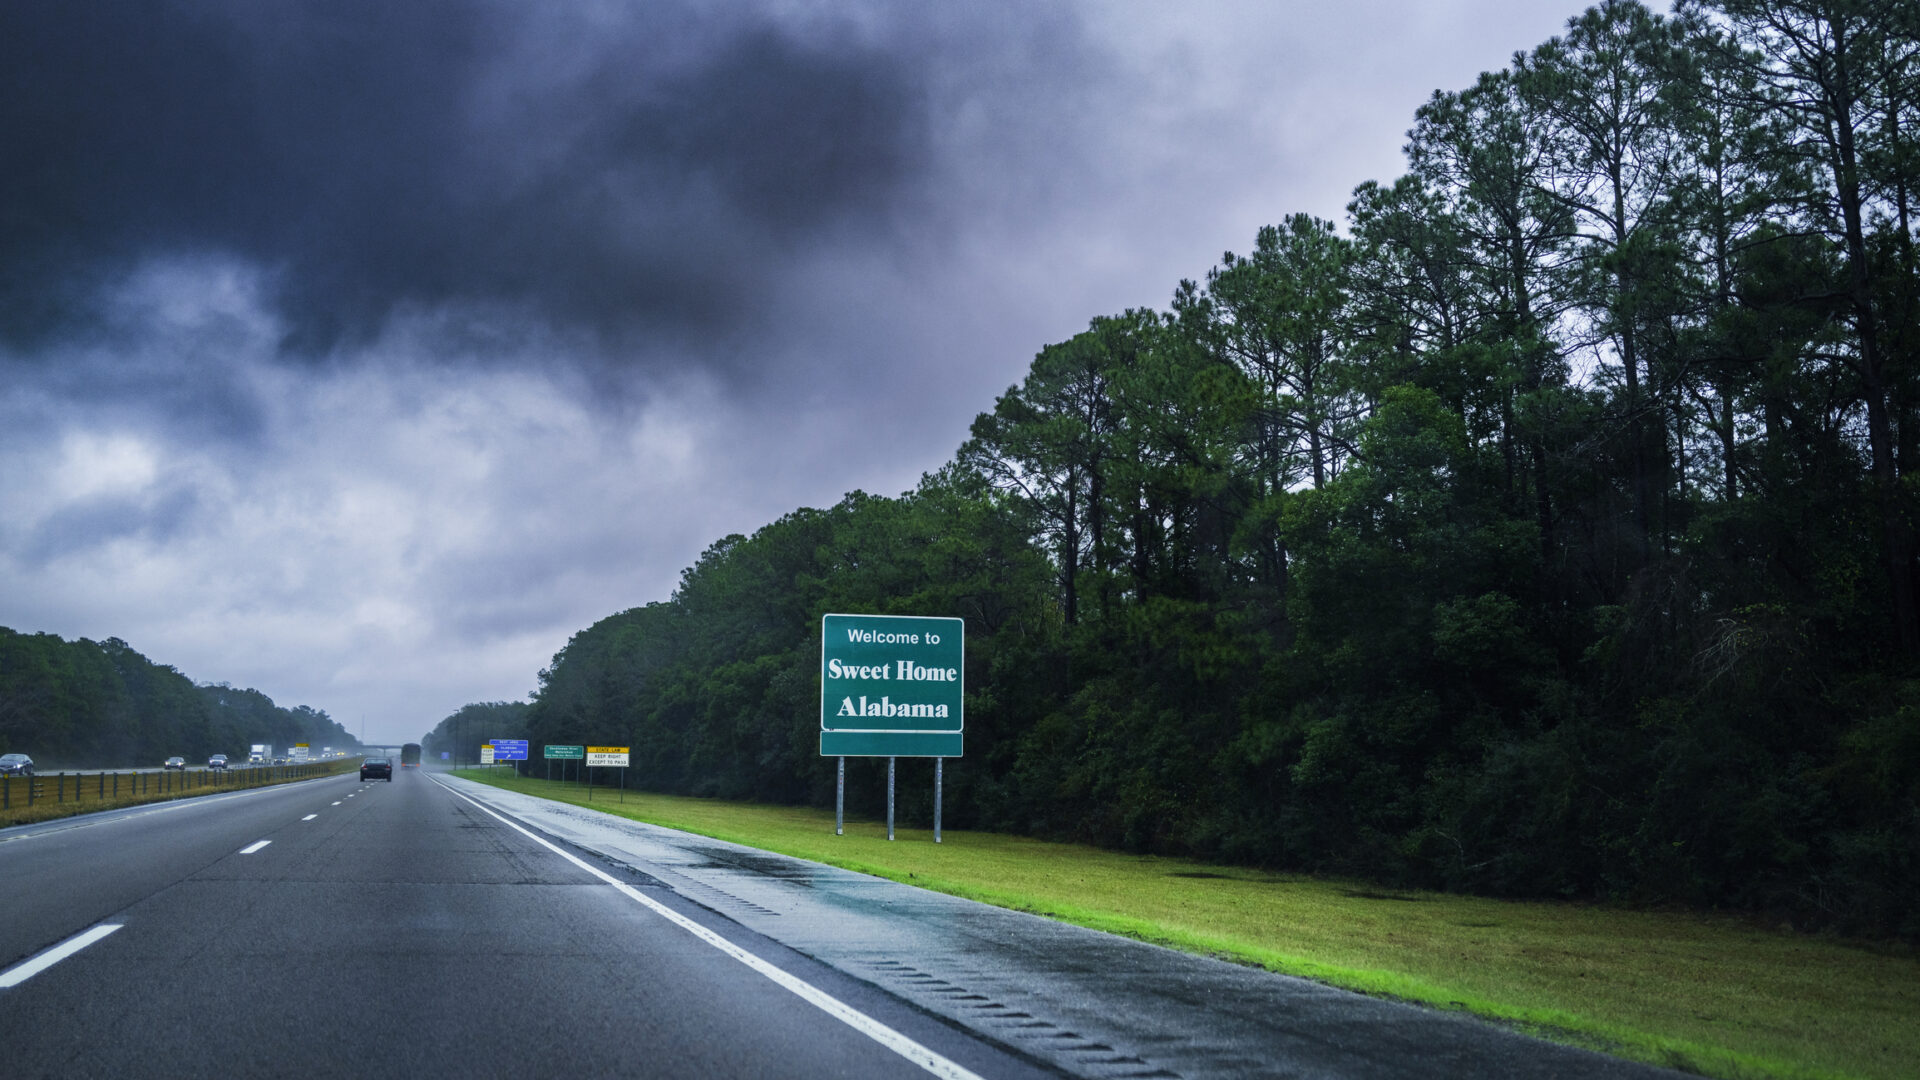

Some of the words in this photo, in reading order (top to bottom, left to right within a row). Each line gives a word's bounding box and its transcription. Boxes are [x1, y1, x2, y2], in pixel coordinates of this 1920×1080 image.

[848, 629, 919, 644] Welcome
[925, 632, 941, 645] to
[828, 658, 891, 680] Sweet
[896, 660, 957, 682] Home
[836, 695, 949, 718] Alabama
